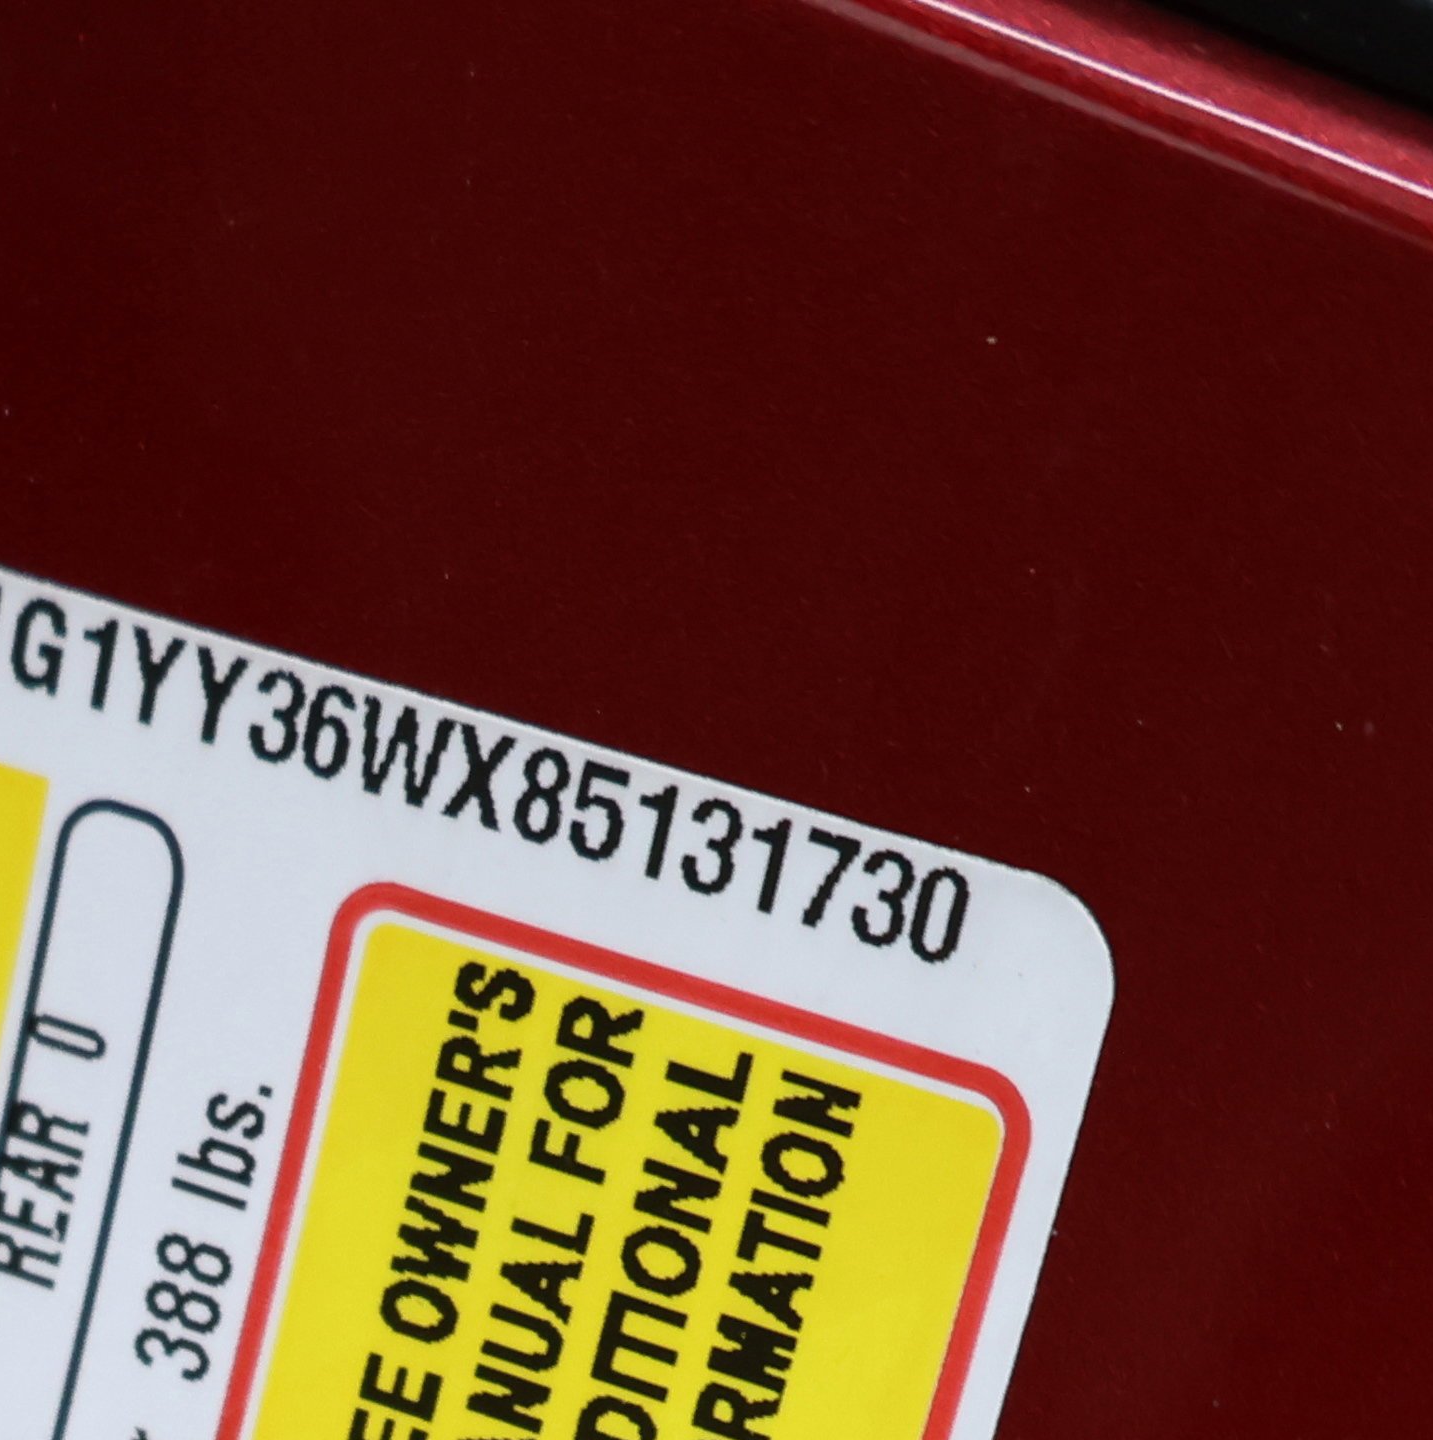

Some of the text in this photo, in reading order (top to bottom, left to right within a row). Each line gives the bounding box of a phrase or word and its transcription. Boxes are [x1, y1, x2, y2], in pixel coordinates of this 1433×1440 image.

[29, 1013, 107, 1062] 0
[531, 996, 645, 1184] FOR
[171, 1083, 273, 1211] lbs.
[379, 960, 535, 1344] OWNER'S
[133, 1234, 233, 1384] 388
